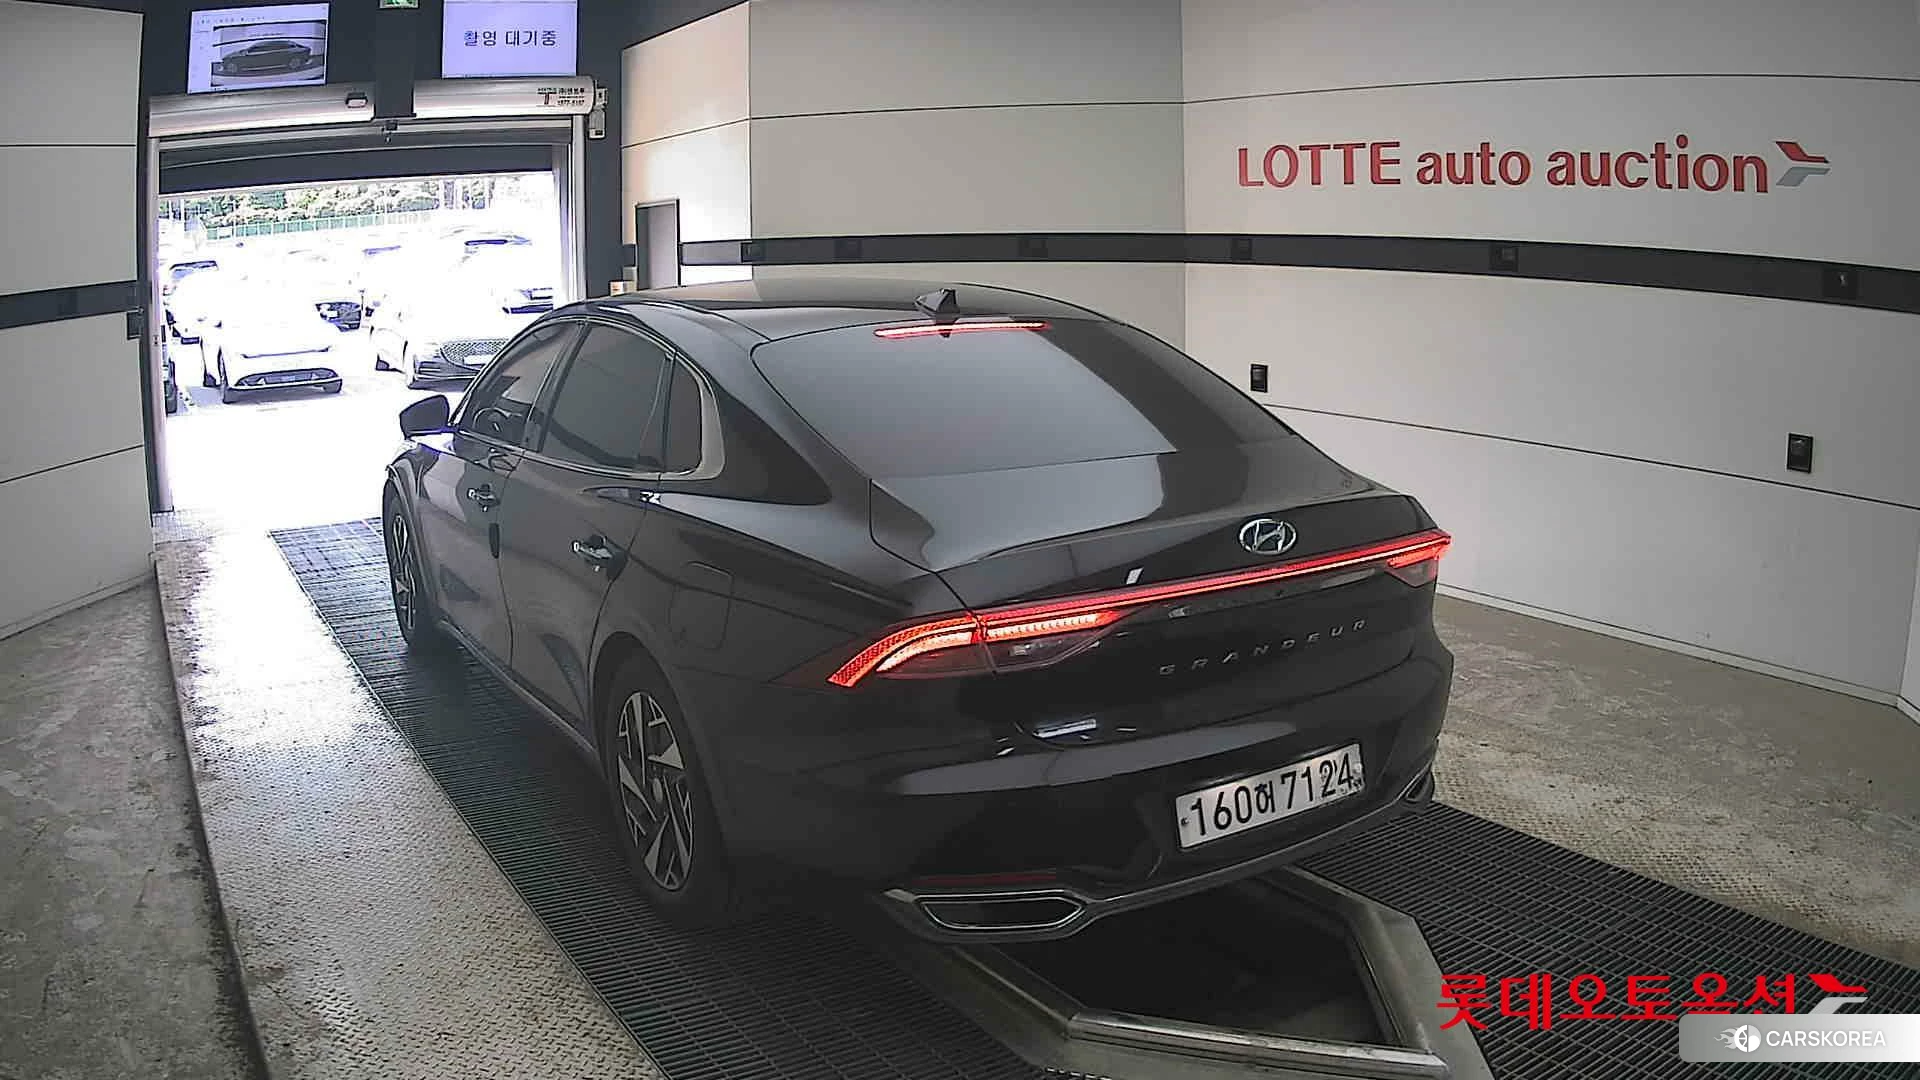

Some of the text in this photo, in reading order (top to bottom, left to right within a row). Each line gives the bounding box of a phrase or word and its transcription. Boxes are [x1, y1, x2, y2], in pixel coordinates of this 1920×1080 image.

[505, 29, 556, 47] 대기중
[1238, 134, 1769, 194] LOTTE auto auction
[1159, 619, 1366, 675] GRANDEUR
